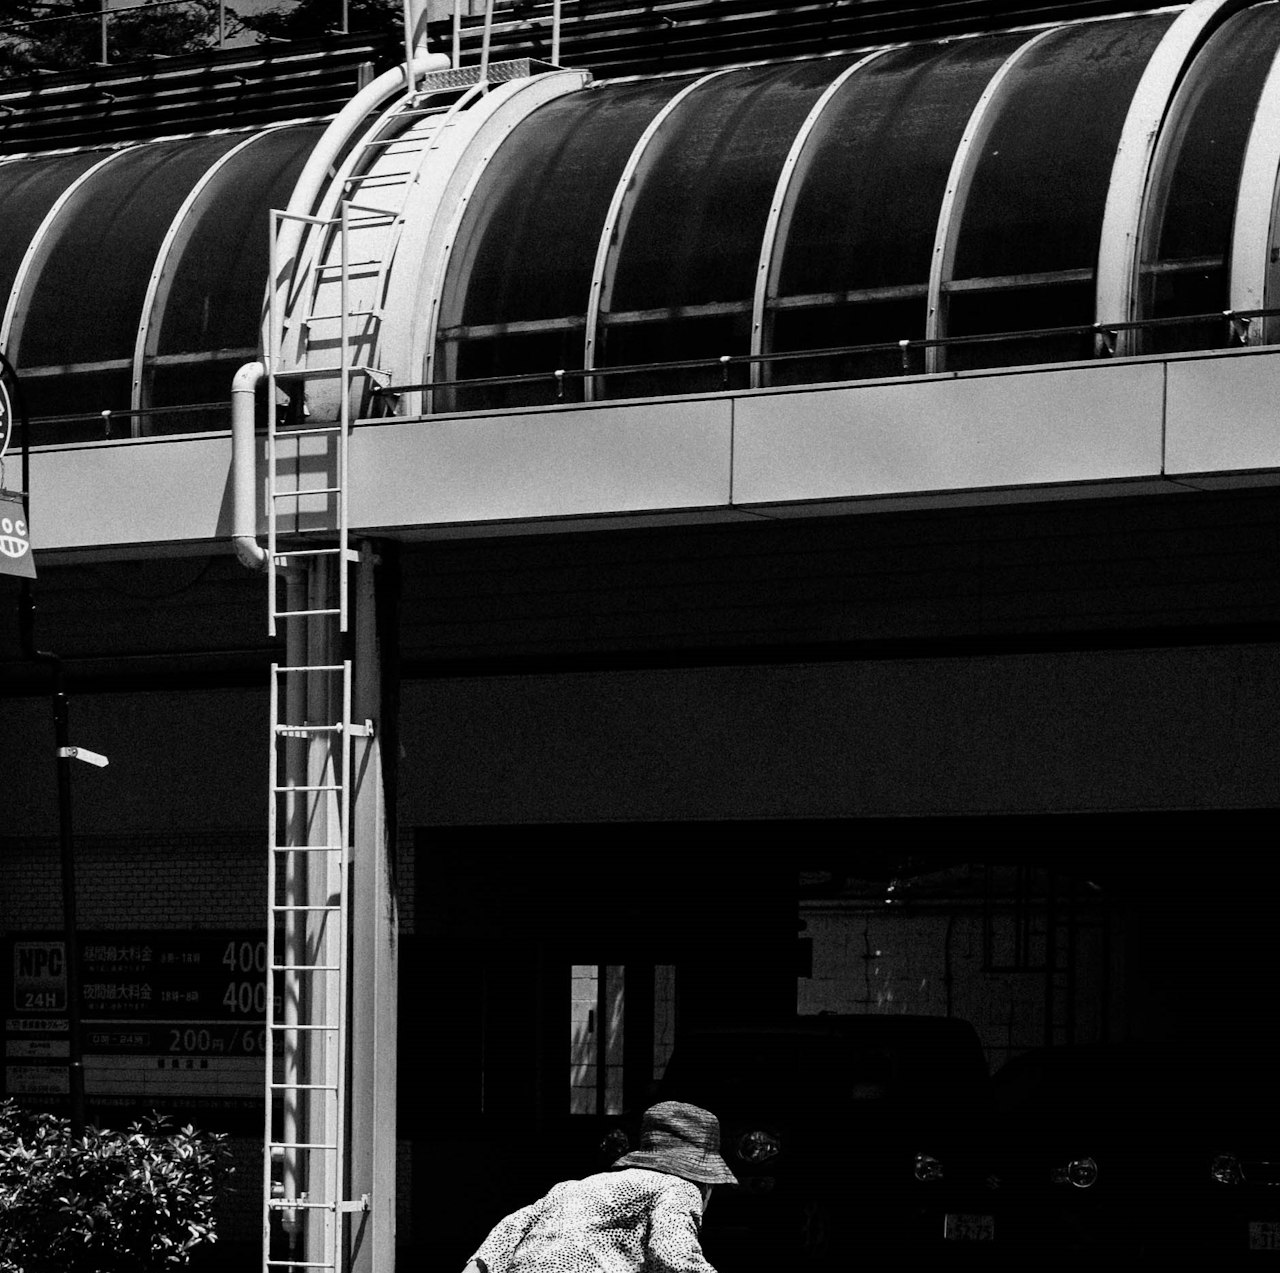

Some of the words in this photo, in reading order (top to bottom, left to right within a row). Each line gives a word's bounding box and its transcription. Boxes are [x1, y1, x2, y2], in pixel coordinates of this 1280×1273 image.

[19, 948, 62, 977] NPC
[24, 992, 56, 1008] 24H
[82, 983, 152, 1000] 夜間最大料金
